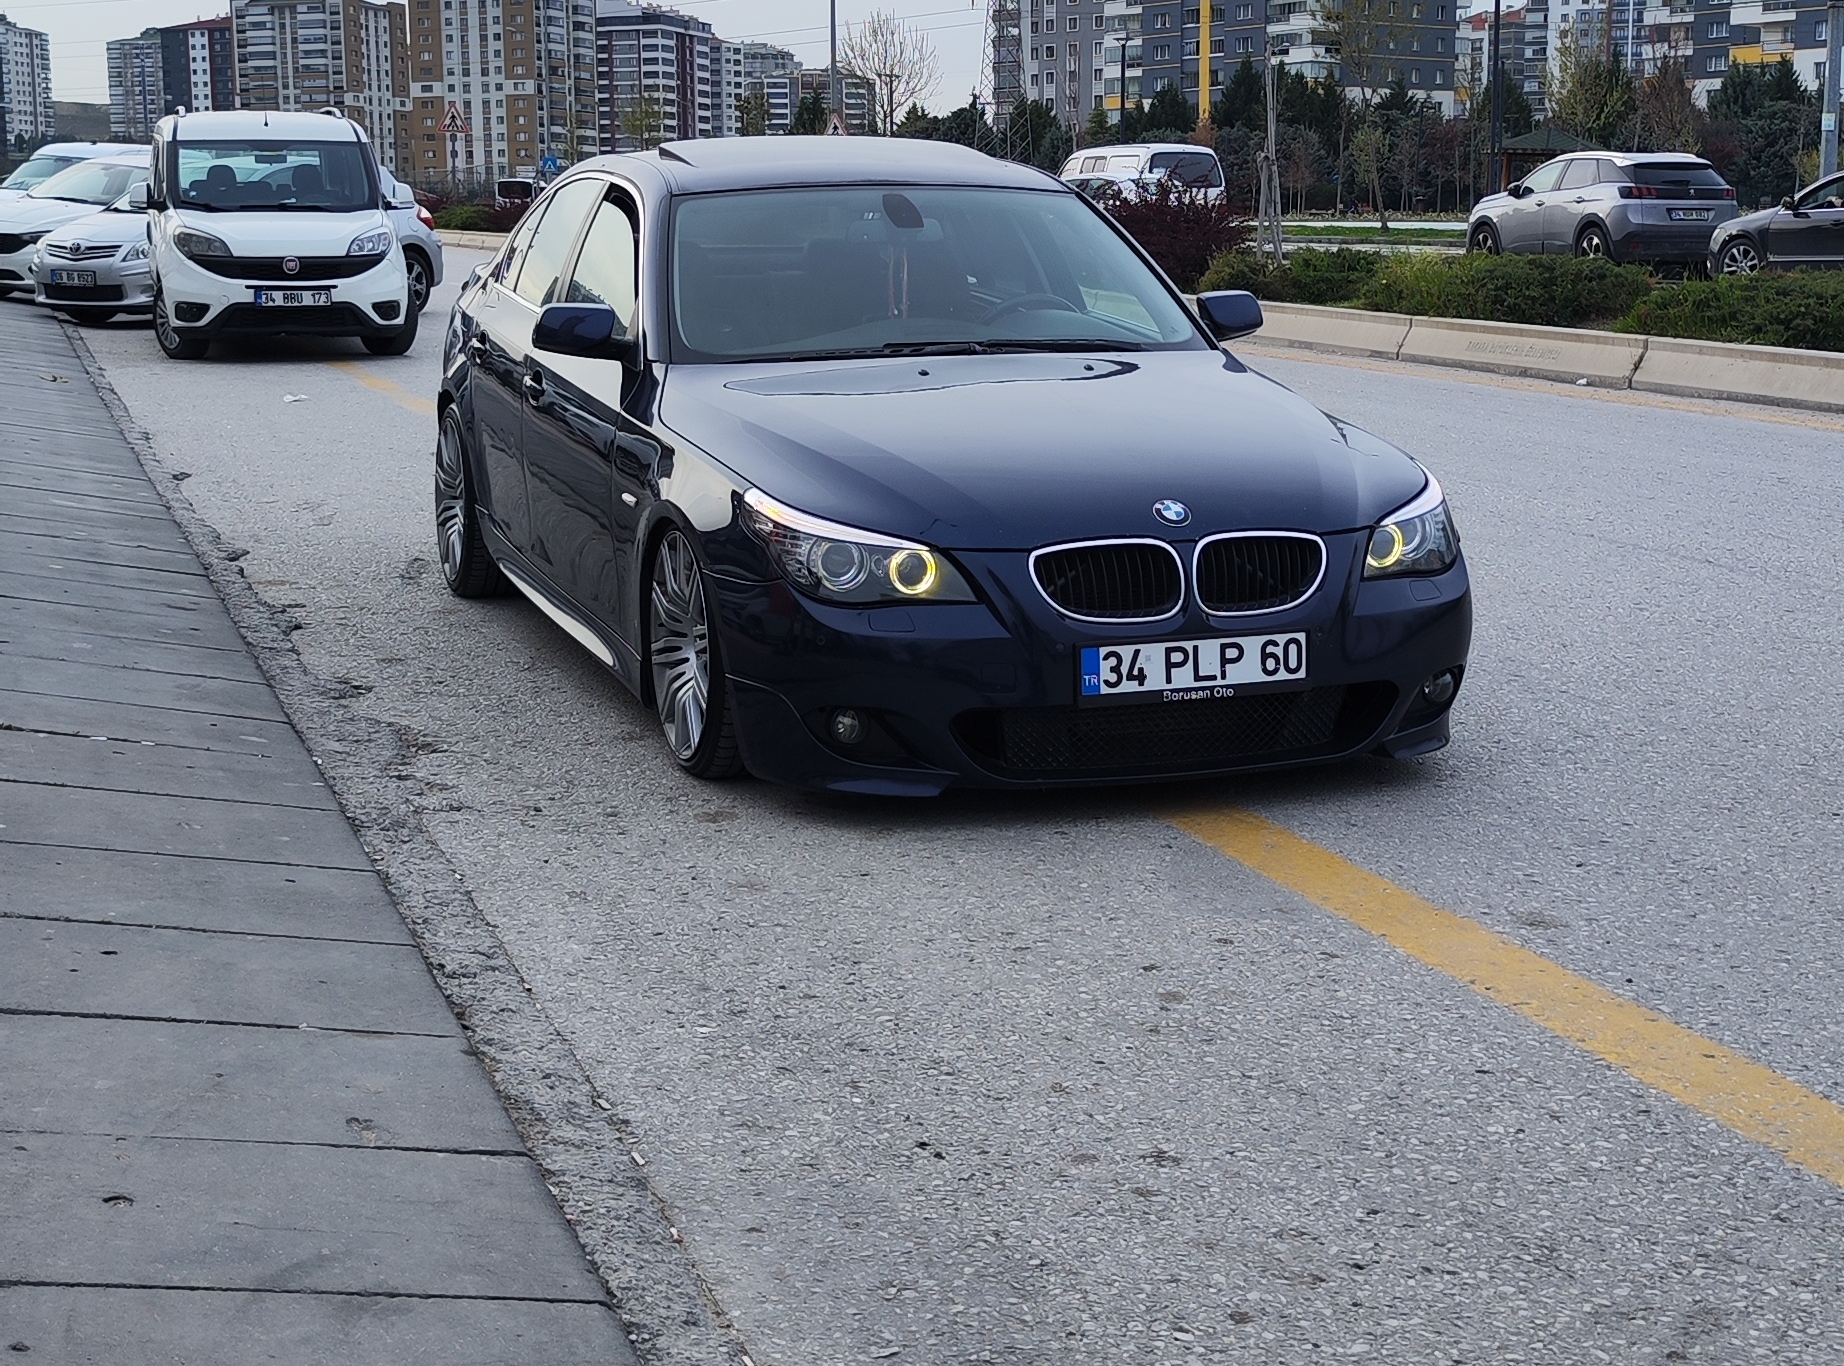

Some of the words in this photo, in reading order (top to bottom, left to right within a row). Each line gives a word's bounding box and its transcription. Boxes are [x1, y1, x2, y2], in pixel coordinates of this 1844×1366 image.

[262, 292, 276, 305] 34
[282, 292, 304, 305] BBU
[310, 291, 330, 305] 173
[1101, 648, 1148, 689] 34
[1164, 641, 1245, 685] PLP
[1260, 637, 1303, 677] 60
[1083, 674, 1099, 687] TR
[1162, 689, 1211, 702] Borusan
[1213, 686, 1235, 698] Oto
